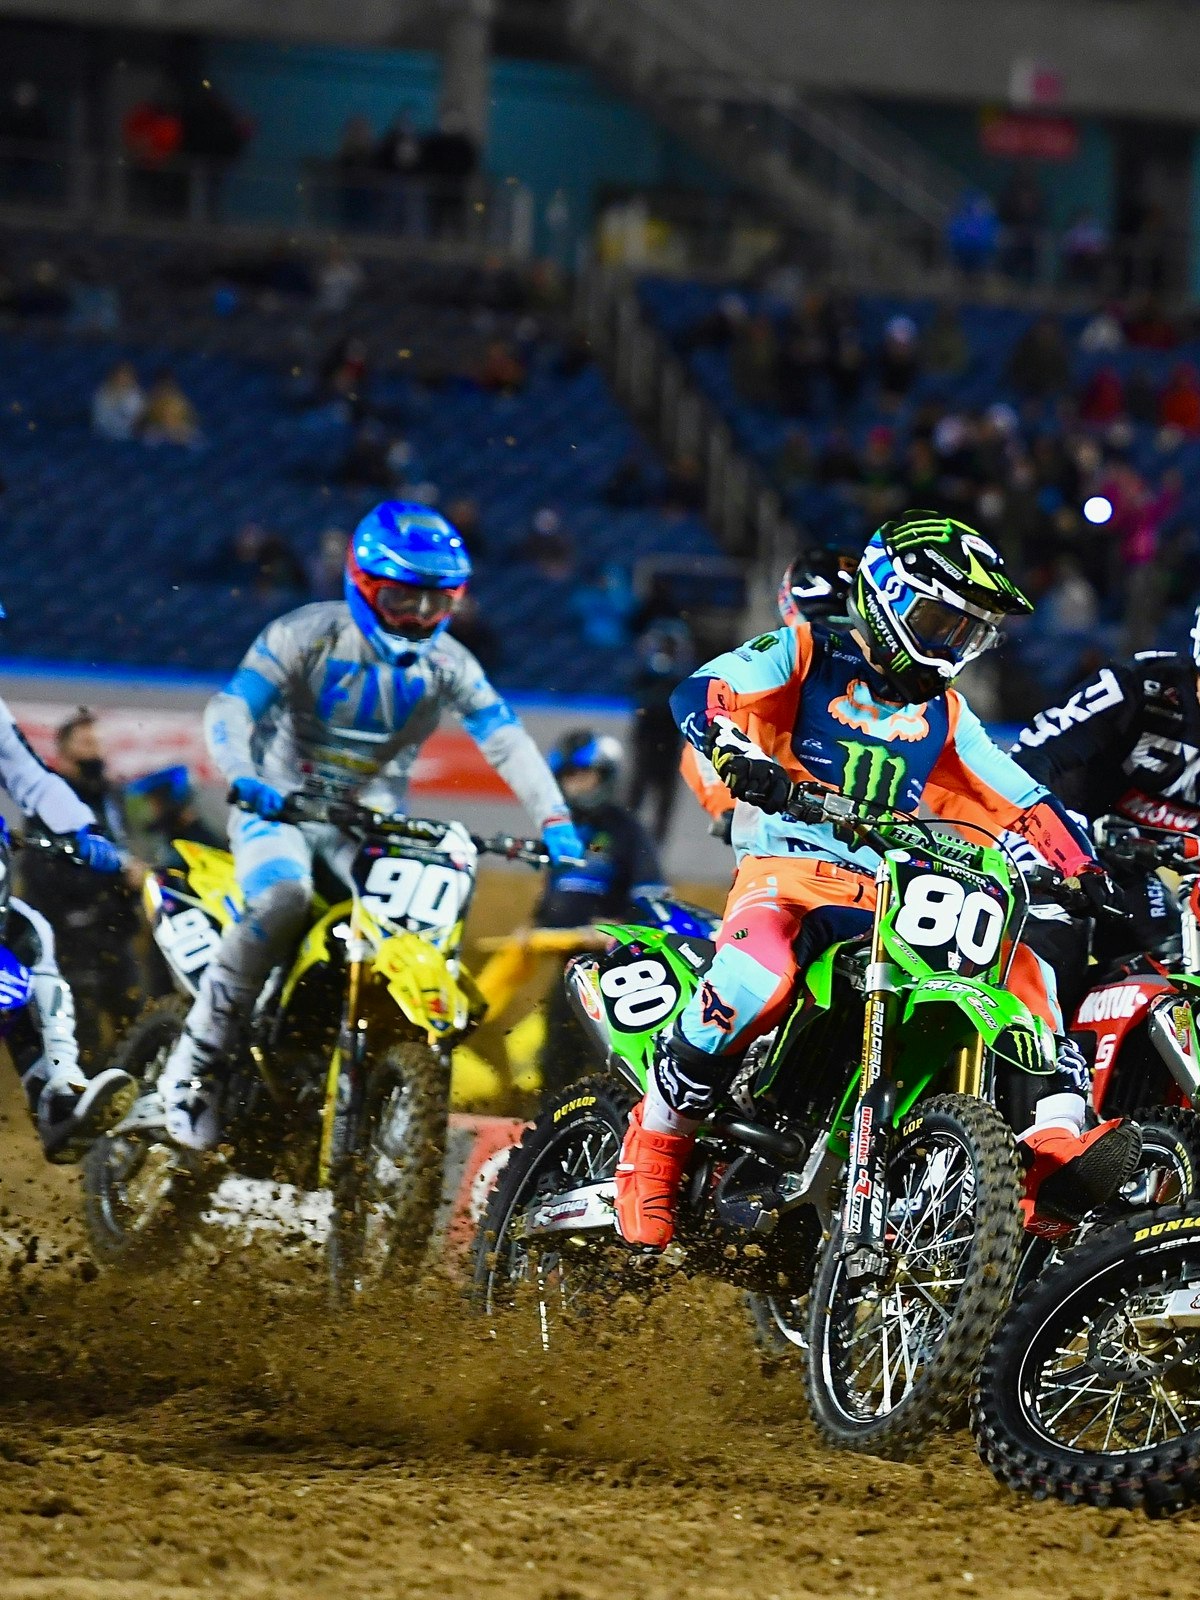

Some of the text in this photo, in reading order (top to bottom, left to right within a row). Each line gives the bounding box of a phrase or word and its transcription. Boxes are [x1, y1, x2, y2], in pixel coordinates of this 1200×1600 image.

[866, 593, 899, 653] MONSTER
[362, 857, 470, 927] 90
[895, 873, 1004, 965] 80
[155, 907, 222, 973] 90
[600, 959, 677, 1027] 80
[1077, 984, 1142, 1024] MOTUL
[553, 1096, 597, 1122] DUNLOP
[857, 1106, 873, 1166] BRAKING
